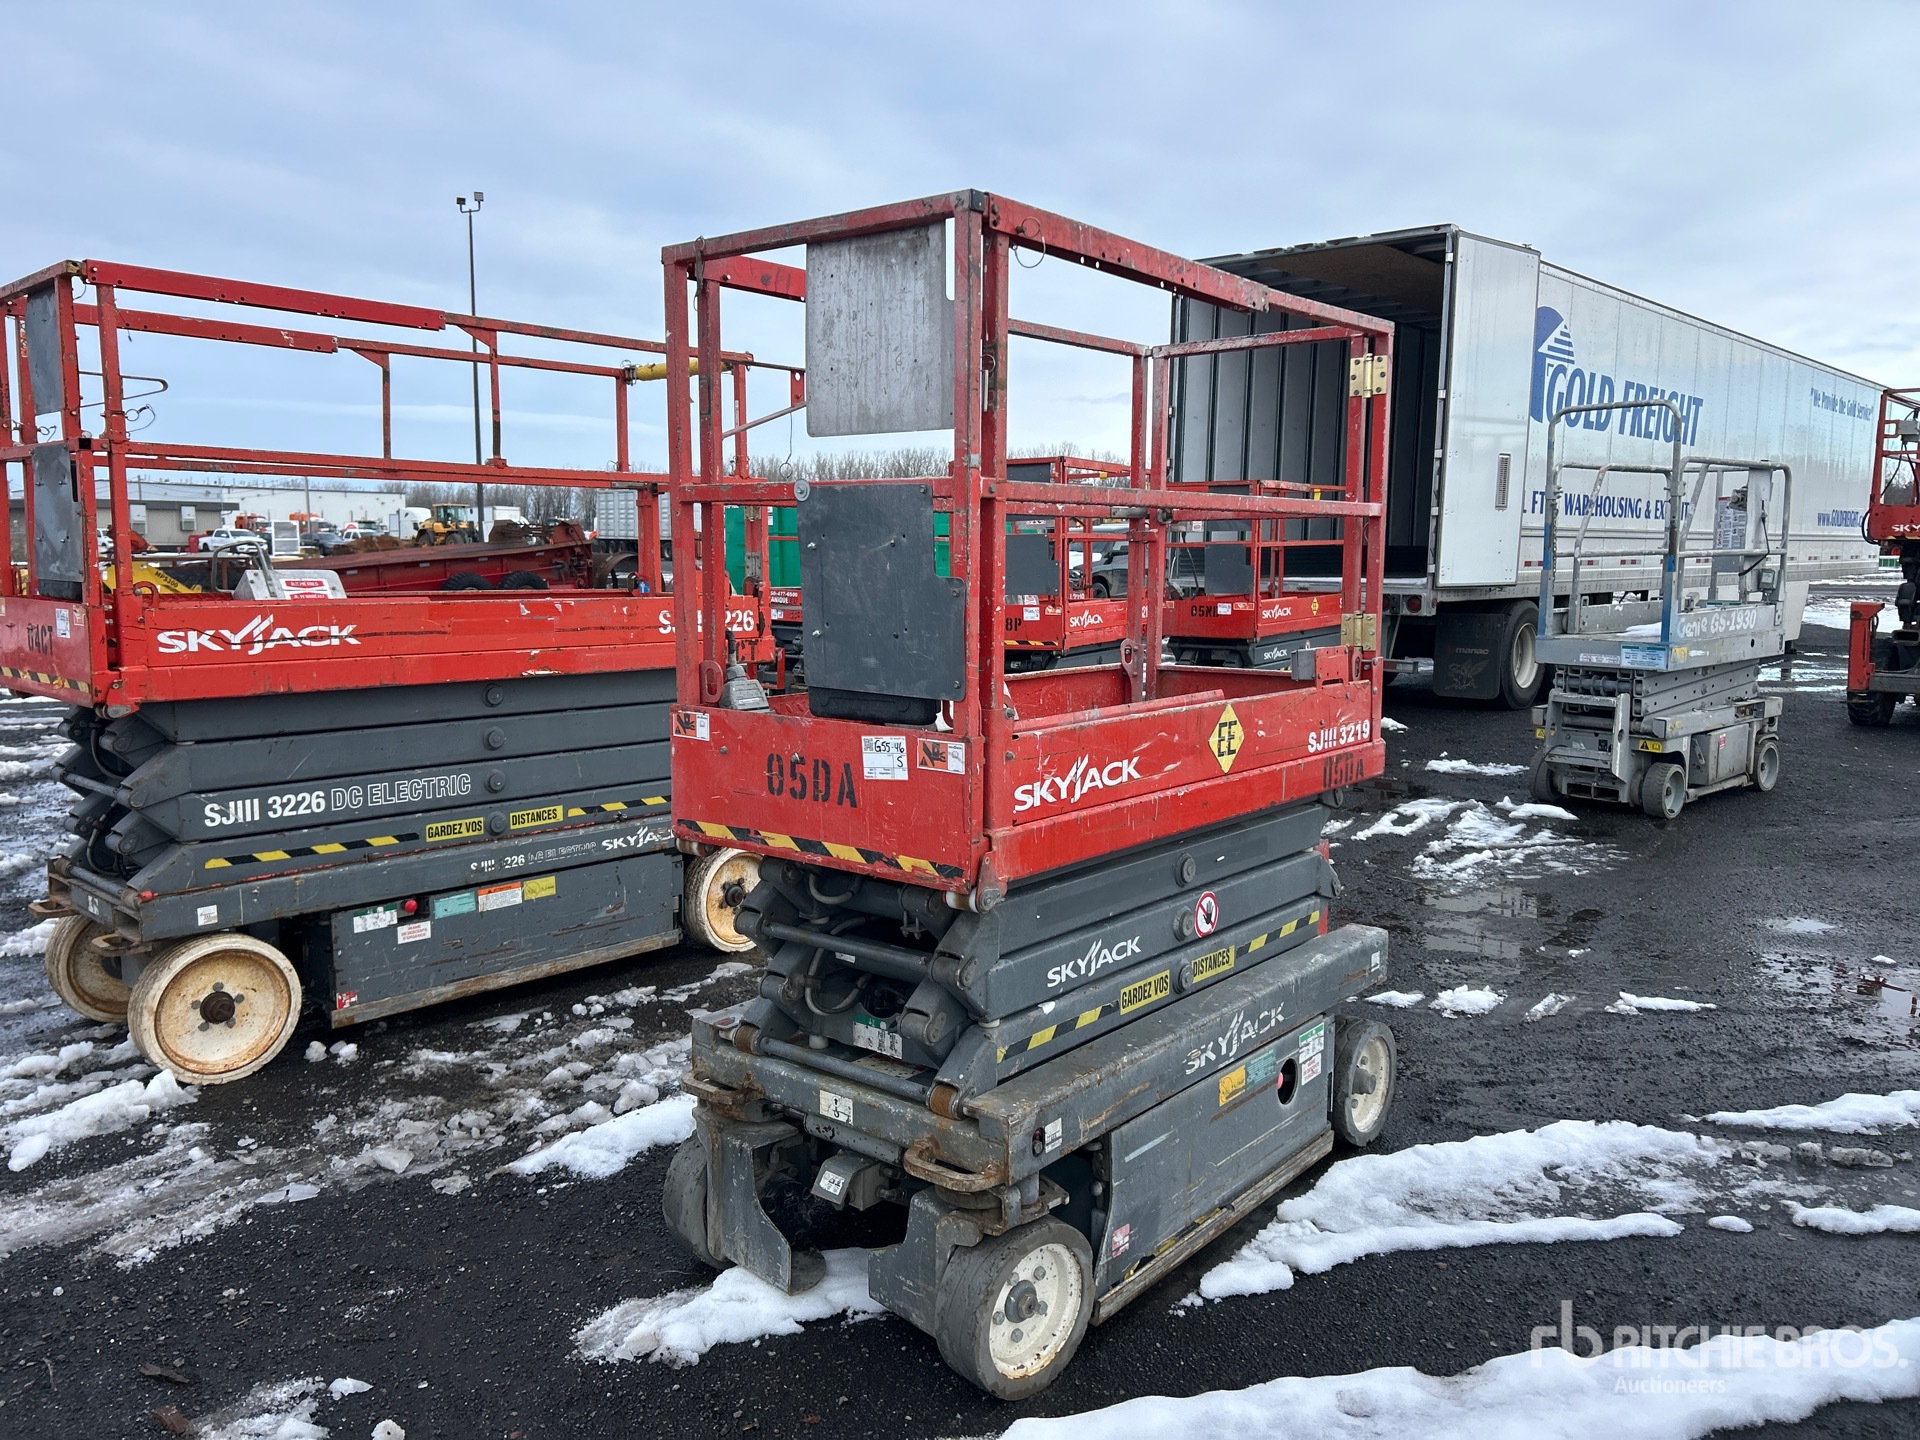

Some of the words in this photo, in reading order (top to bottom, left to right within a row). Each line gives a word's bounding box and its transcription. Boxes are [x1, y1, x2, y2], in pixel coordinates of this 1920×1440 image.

[1546, 364, 1615, 432] GOLD
[1618, 380, 1704, 447] FREIGHT
[1564, 492, 1642, 519] WARHOUSING
[1645, 500, 1651, 519] &
[154, 570, 179, 588] MPS300
[770, 596, 789, 604] ANIQUE
[1262, 604, 1292, 620] SKYJACK
[1069, 609, 1104, 628] SKYJACK
[1678, 616, 1708, 639] Genie
[1710, 609, 1758, 635] GS-1930
[156, 613, 362, 656] SKYJACK
[1263, 647, 1289, 660] SKYJACK
[1455, 647, 1489, 655] manac
[1217, 720, 1238, 757] EE
[1338, 719, 1370, 746] 3219
[874, 739, 905, 754] G55-46
[766, 753, 858, 809] 05DA
[1012, 753, 1142, 813] SKYJACK
[204, 798, 261, 828] SJIII
[267, 790, 326, 819] 3226
[331, 786, 364, 811] DC
[367, 773, 471, 807] ELECTRIC
[427, 823, 463, 840] GARDEZ
[465, 820, 483, 834] VOS
[512, 808, 558, 827] DISTANCES
[500, 855, 526, 870] 226
[1047, 936, 1142, 988] SKYJACK
[1192, 948, 1230, 977] DISTANCES
[1121, 982, 1152, 1009] GARDEZ
[1154, 974, 1169, 998] VOS
[1182, 1001, 1285, 1076] SKYJACK
